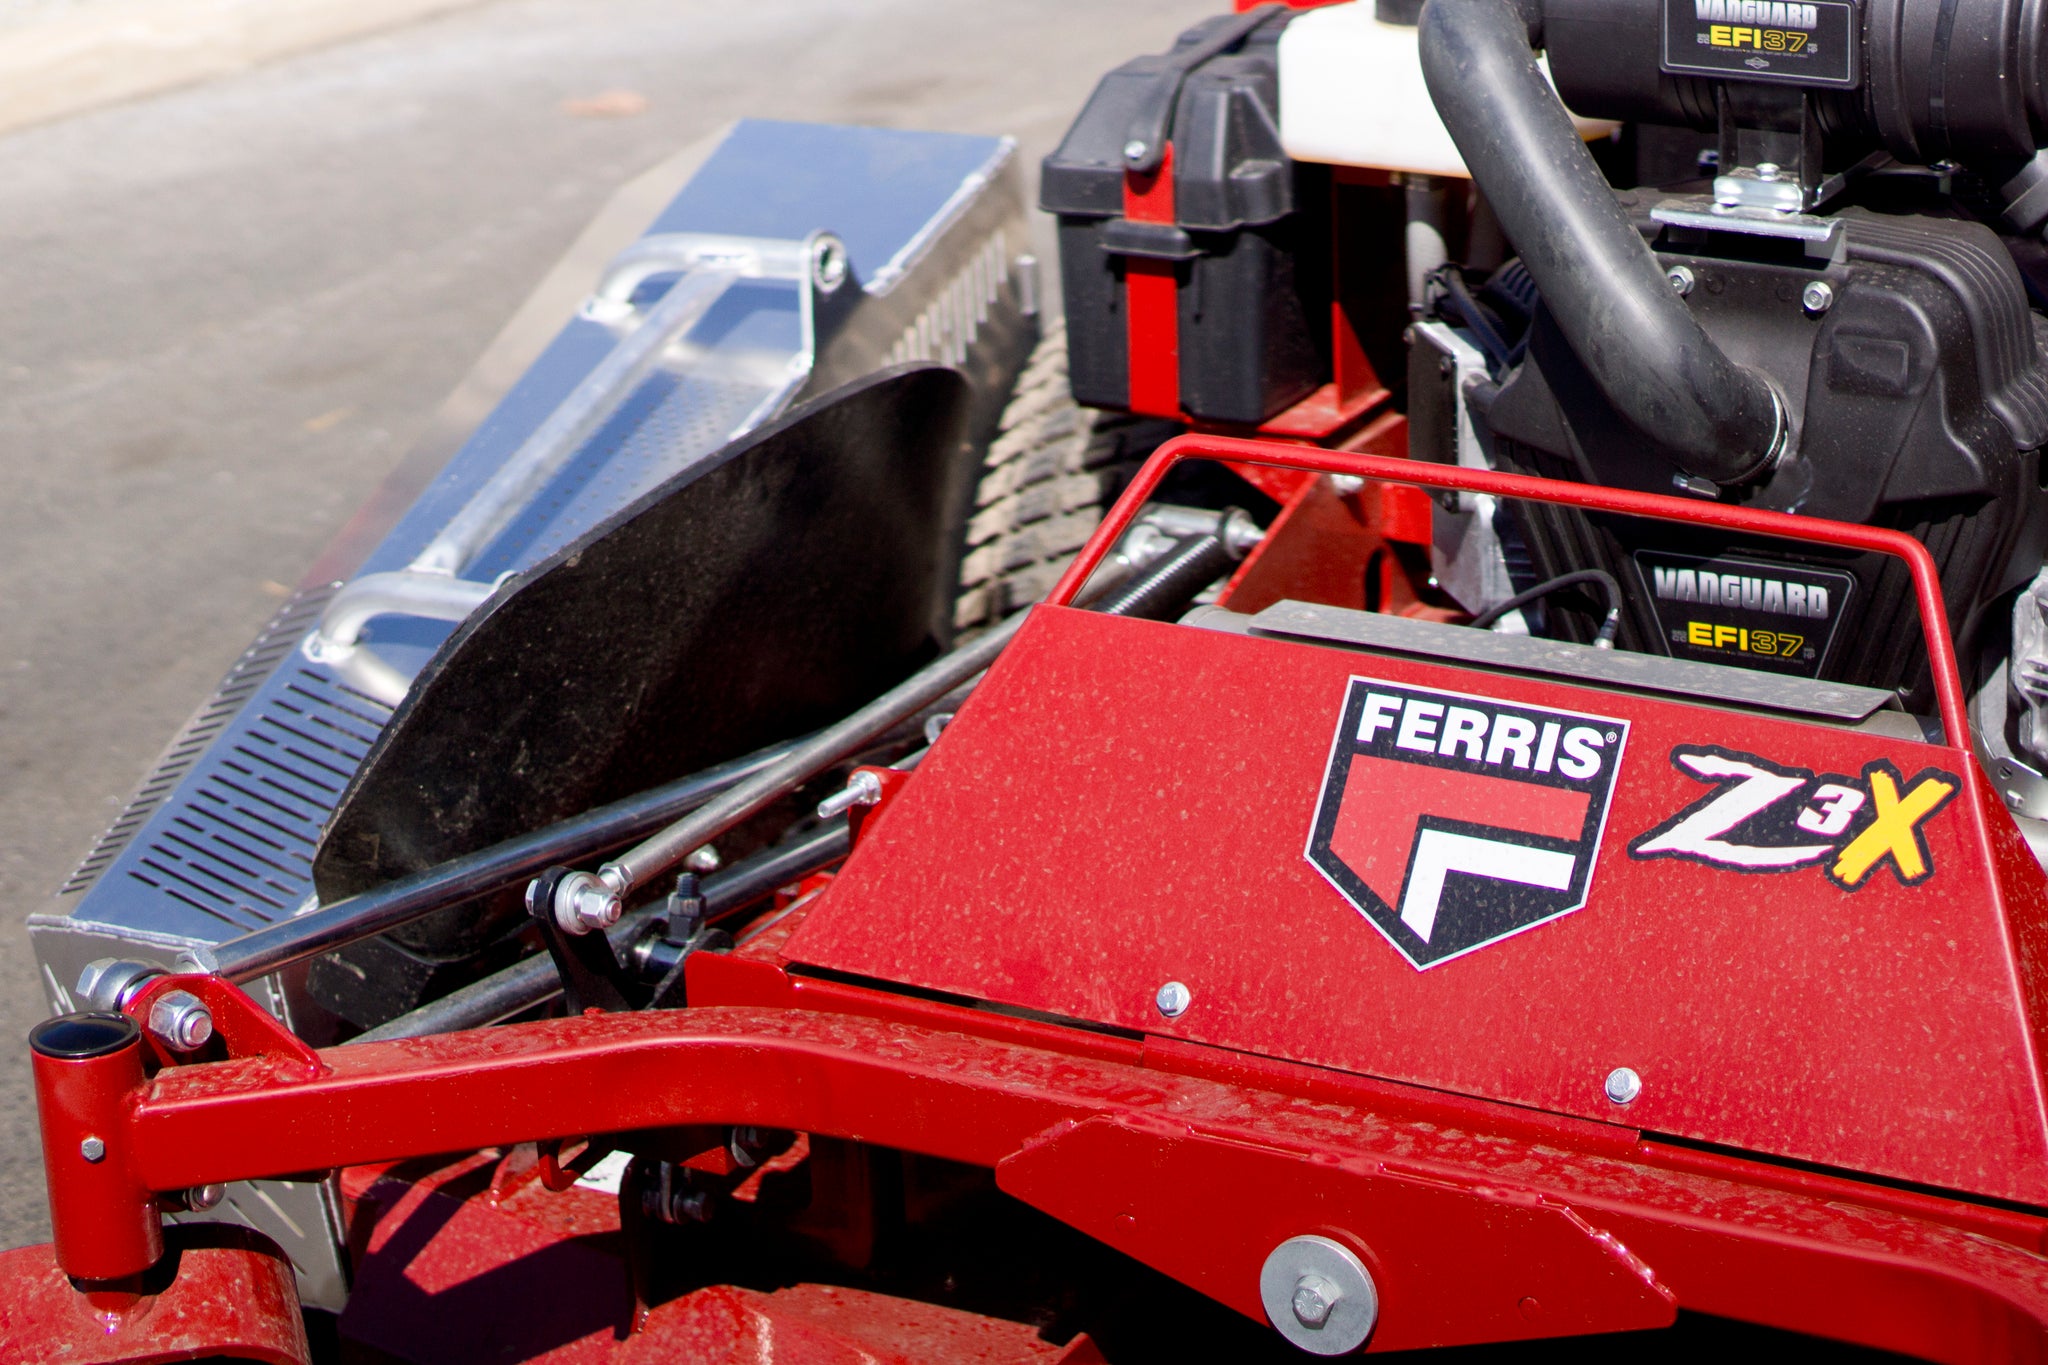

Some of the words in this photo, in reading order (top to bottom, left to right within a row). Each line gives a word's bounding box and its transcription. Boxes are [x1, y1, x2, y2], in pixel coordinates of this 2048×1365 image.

[1694, 0, 1818, 29] VANGUARD
[1654, 566, 1829, 619] VANGUARD
[1356, 692, 1605, 779] FERRIS
[1635, 754, 1954, 885] Z3X
